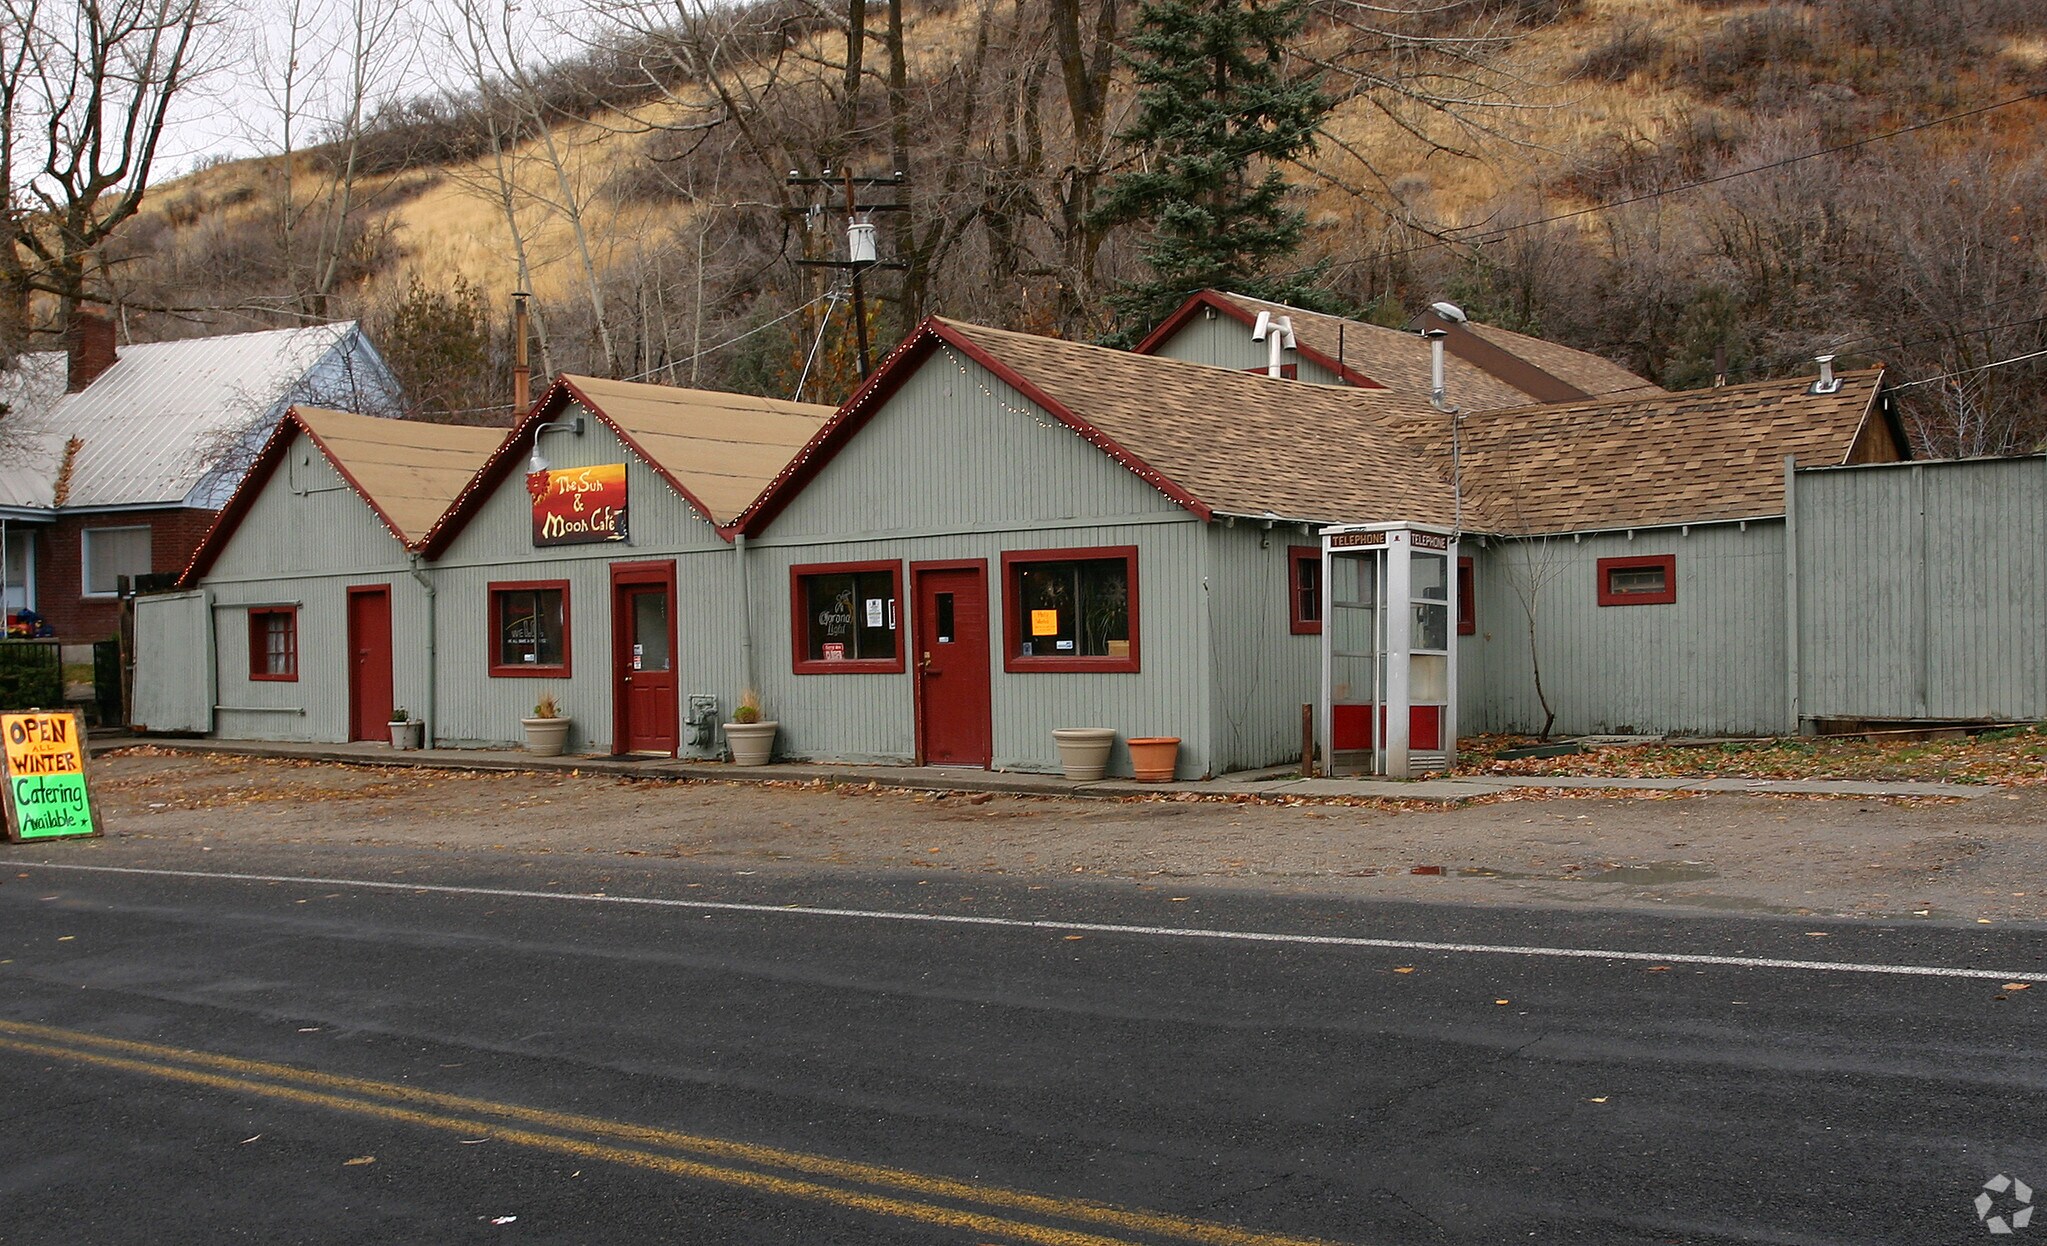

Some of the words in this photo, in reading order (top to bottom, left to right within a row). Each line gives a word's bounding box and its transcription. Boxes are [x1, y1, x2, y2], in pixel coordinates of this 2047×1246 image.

[555, 476, 576, 495] The
[578, 469, 604, 493] Sun
[573, 493, 584, 512] &
[542, 511, 589, 539] Moon
[591, 506, 615, 531] Café
[1332, 533, 1385, 547] TELEPHONE
[1411, 533, 1446, 549] TELEPHONE
[10, 718, 66, 745] OPEN
[11, 752, 77, 773] WINTER
[17, 776, 84, 811] Catering
[23, 808, 76, 831] Available
